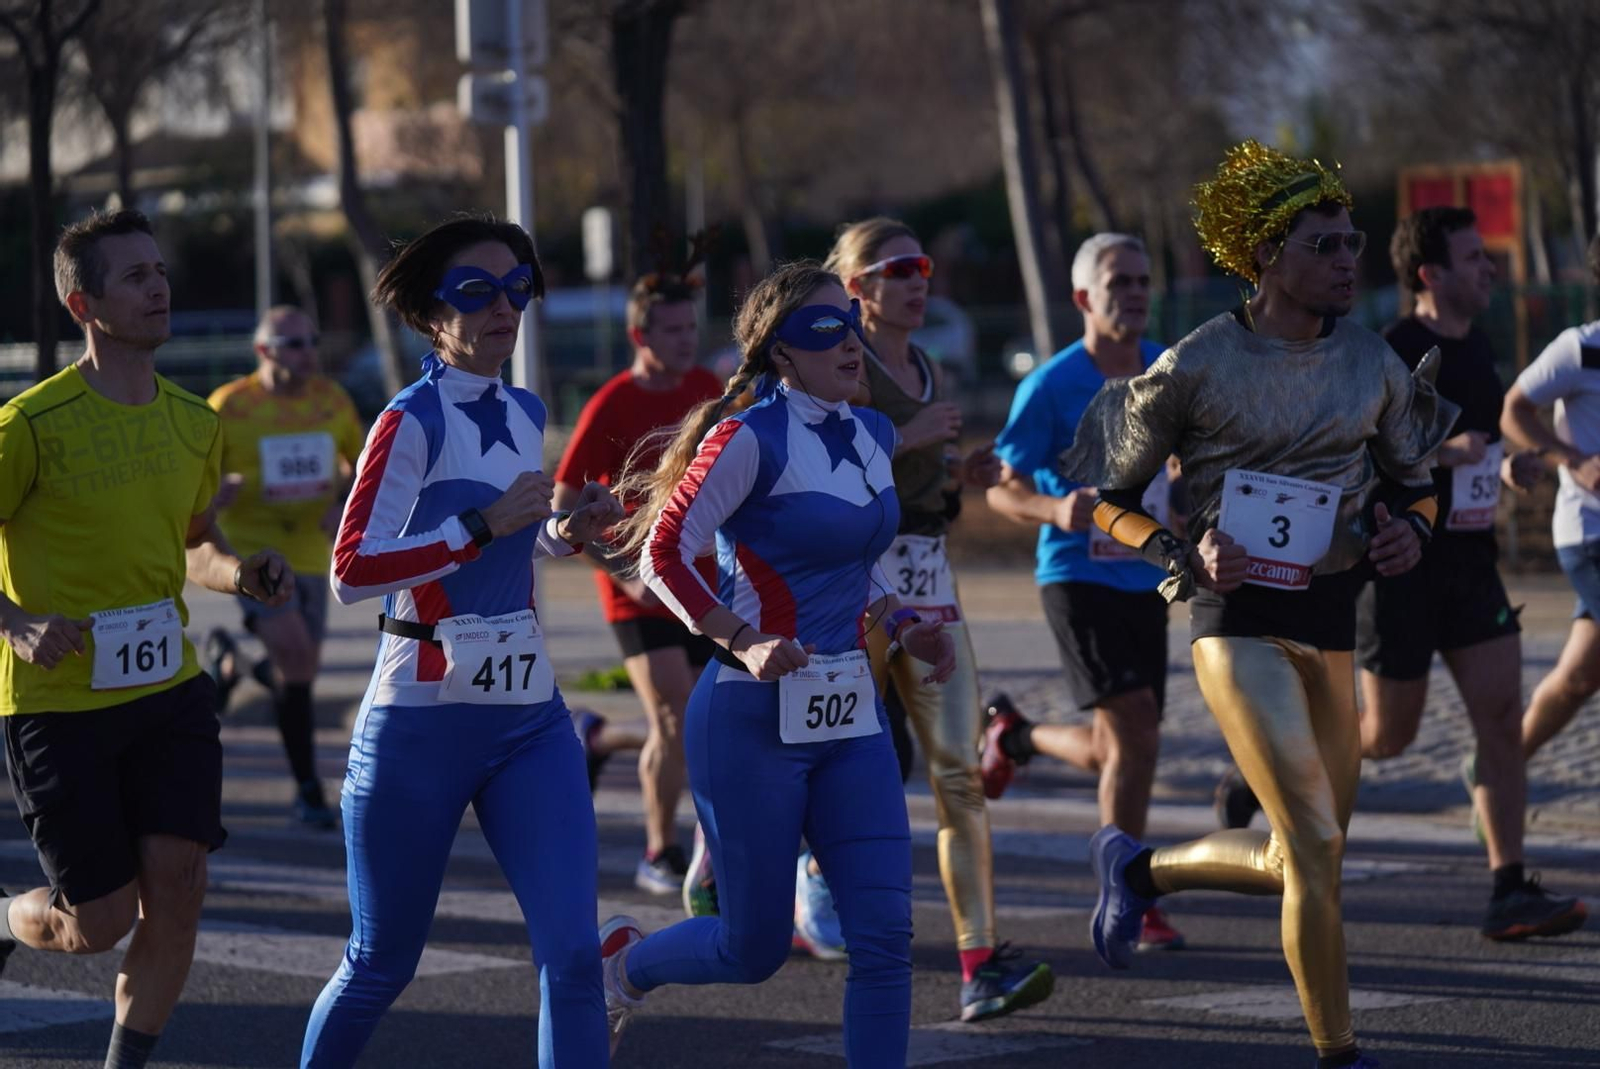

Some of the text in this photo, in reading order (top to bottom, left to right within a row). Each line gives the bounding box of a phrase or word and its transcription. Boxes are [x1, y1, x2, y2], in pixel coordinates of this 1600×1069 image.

[1268, 515, 1291, 548] 3
[898, 568, 936, 596] 321
[463, 631, 489, 640] IMDECO
[116, 635, 167, 675] 161
[471, 653, 536, 692] 417
[806, 691, 857, 729] 502
